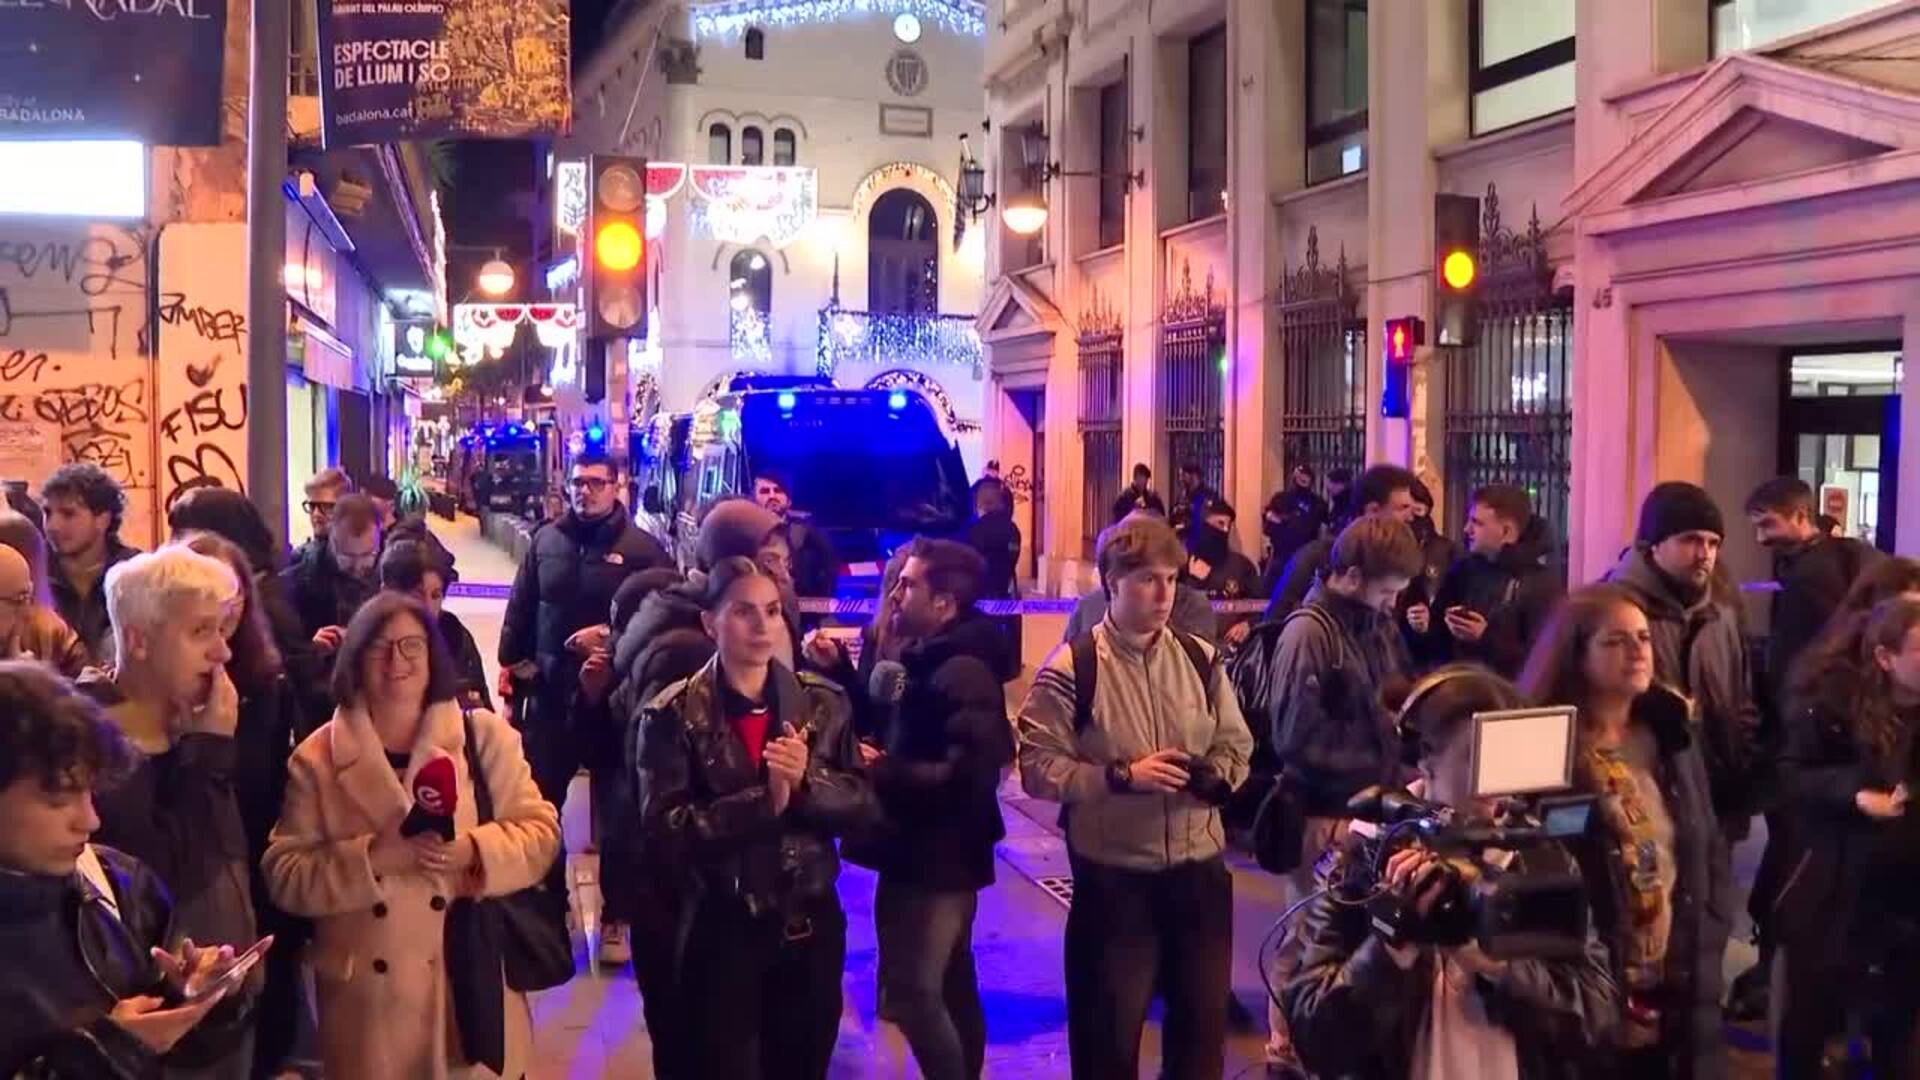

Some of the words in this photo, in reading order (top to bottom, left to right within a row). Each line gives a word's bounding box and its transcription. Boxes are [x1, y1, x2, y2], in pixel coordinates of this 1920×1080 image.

[334, 40, 449, 65] ESPECTACLE
[335, 66, 354, 90] DE
[357, 63, 404, 87] LLUM
[408, 62, 414, 85] I
[418, 62, 451, 82] SO
[335, 100, 413, 125] badalona.cat
